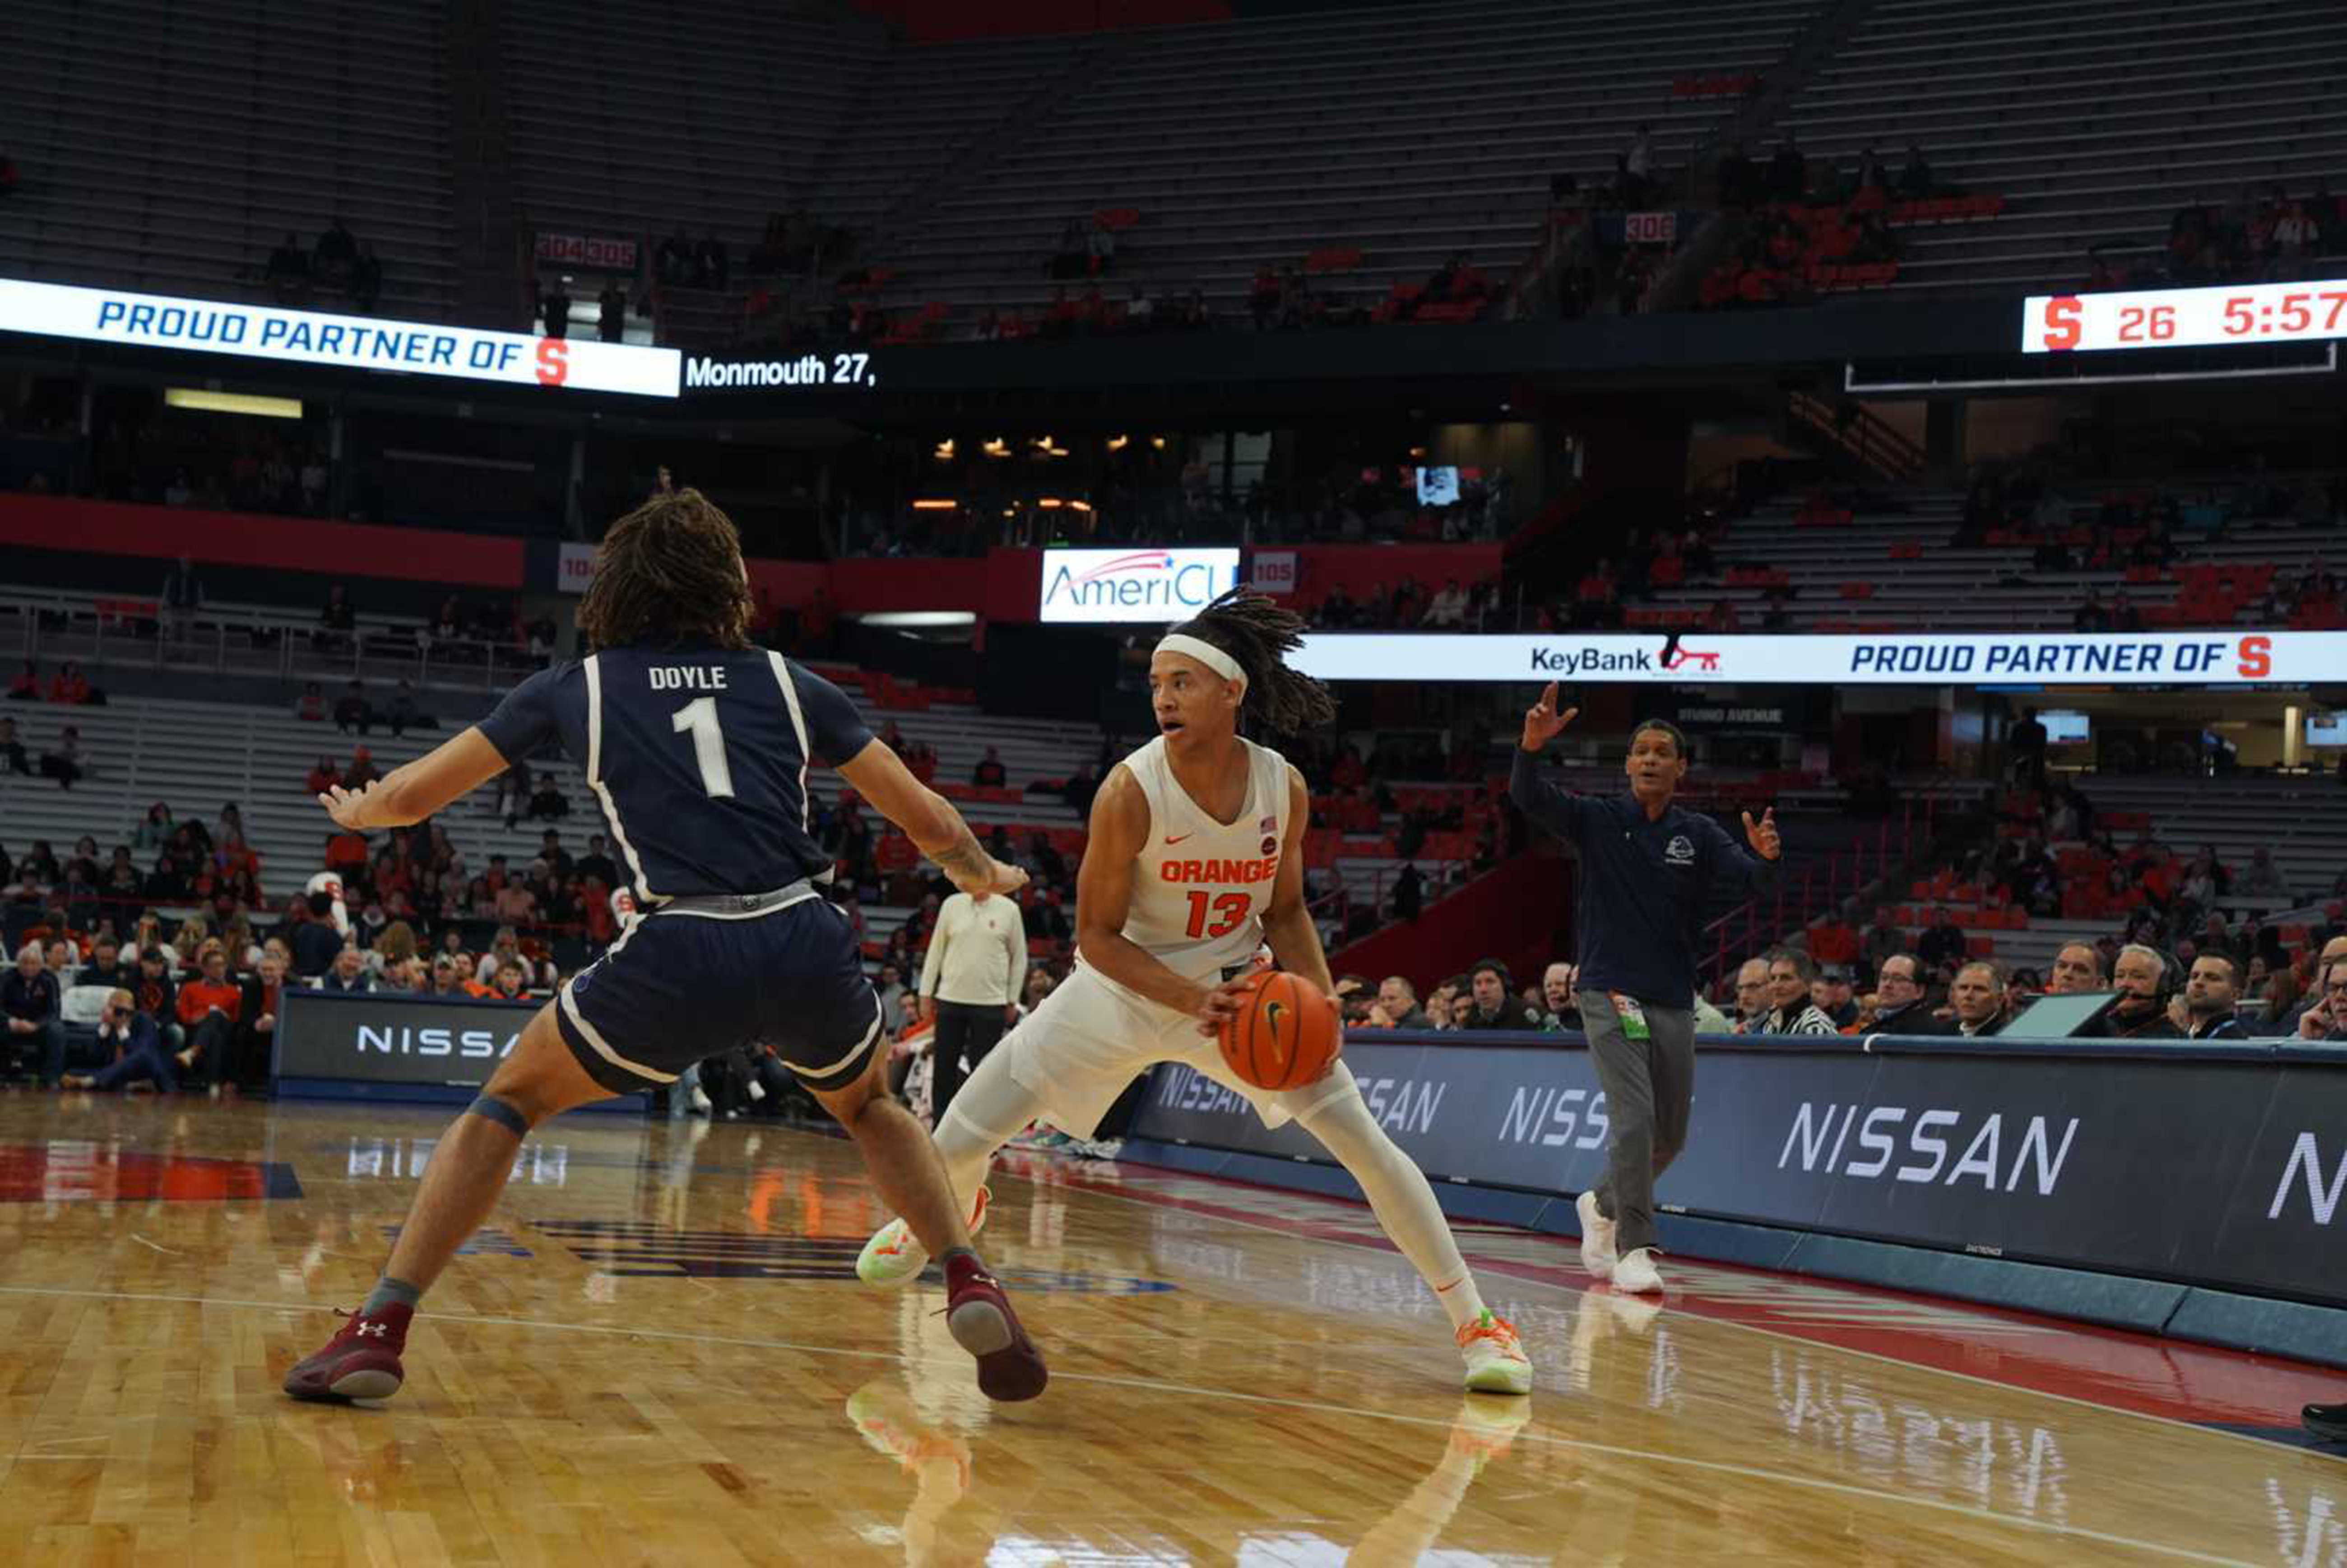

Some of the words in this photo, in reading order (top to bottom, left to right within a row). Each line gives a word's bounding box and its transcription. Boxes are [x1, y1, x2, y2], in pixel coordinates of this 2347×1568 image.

[2044, 295, 2082, 350] S
[2119, 306, 2175, 342] 26
[2223, 292, 2347, 334] 5:57
[98, 301, 246, 343] PROUD
[260, 319, 456, 364] PARTNER
[469, 341, 523, 370] OF
[536, 335, 568, 386] S
[686, 355, 825, 388] Monmouth
[833, 353, 876, 387] 27,
[1257, 563, 1291, 582] 105
[1531, 648, 1650, 675] KeyBank
[1851, 645, 1976, 672] PROUD
[1986, 645, 2162, 672] PARTNER
[2173, 644, 2226, 671] OF
[2237, 637, 2271, 677] S
[649, 666, 728, 690] DOYLE
[672, 696, 735, 798] 1
[1161, 857, 1278, 883] ORANGE
[1186, 891, 1252, 938] 13
[1777, 1102, 2079, 1196] NISSAN
